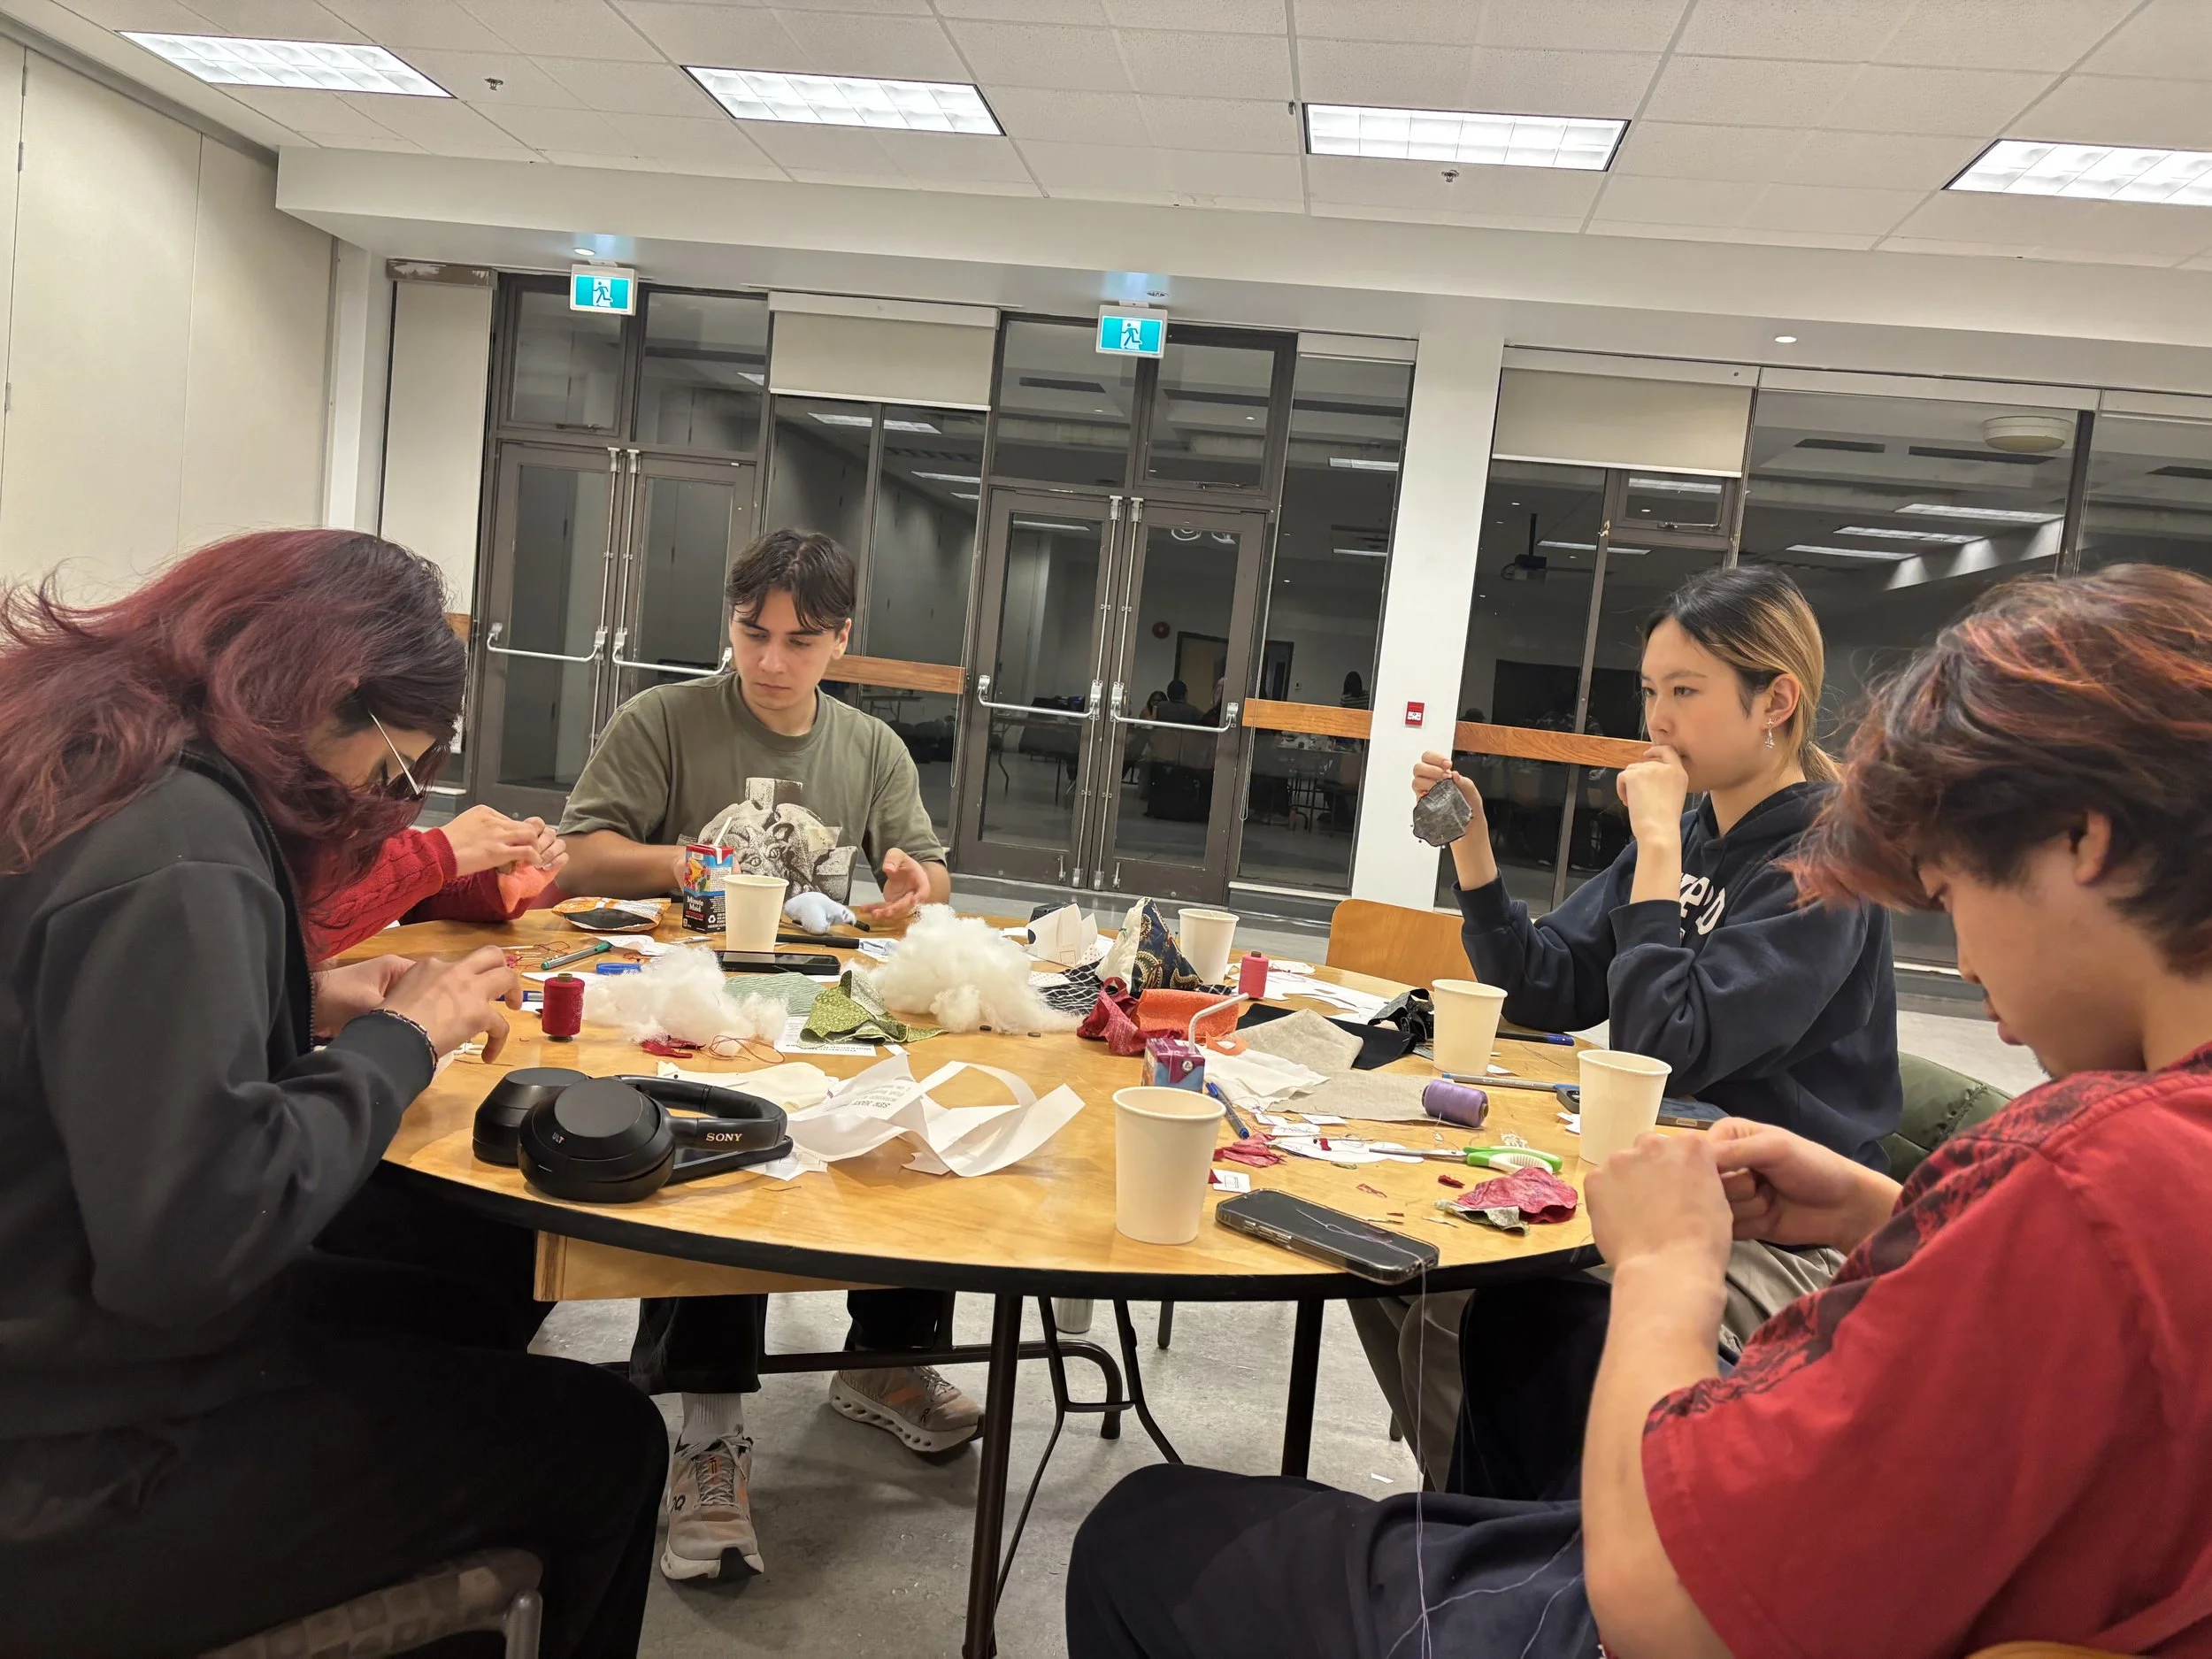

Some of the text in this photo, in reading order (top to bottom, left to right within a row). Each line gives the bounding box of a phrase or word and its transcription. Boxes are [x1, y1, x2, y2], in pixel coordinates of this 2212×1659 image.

[687, 895, 704, 907] Minute
[689, 902, 702, 912] Maid
[552, 1133, 565, 1144] ULT
[705, 1133, 743, 1141] SONY
